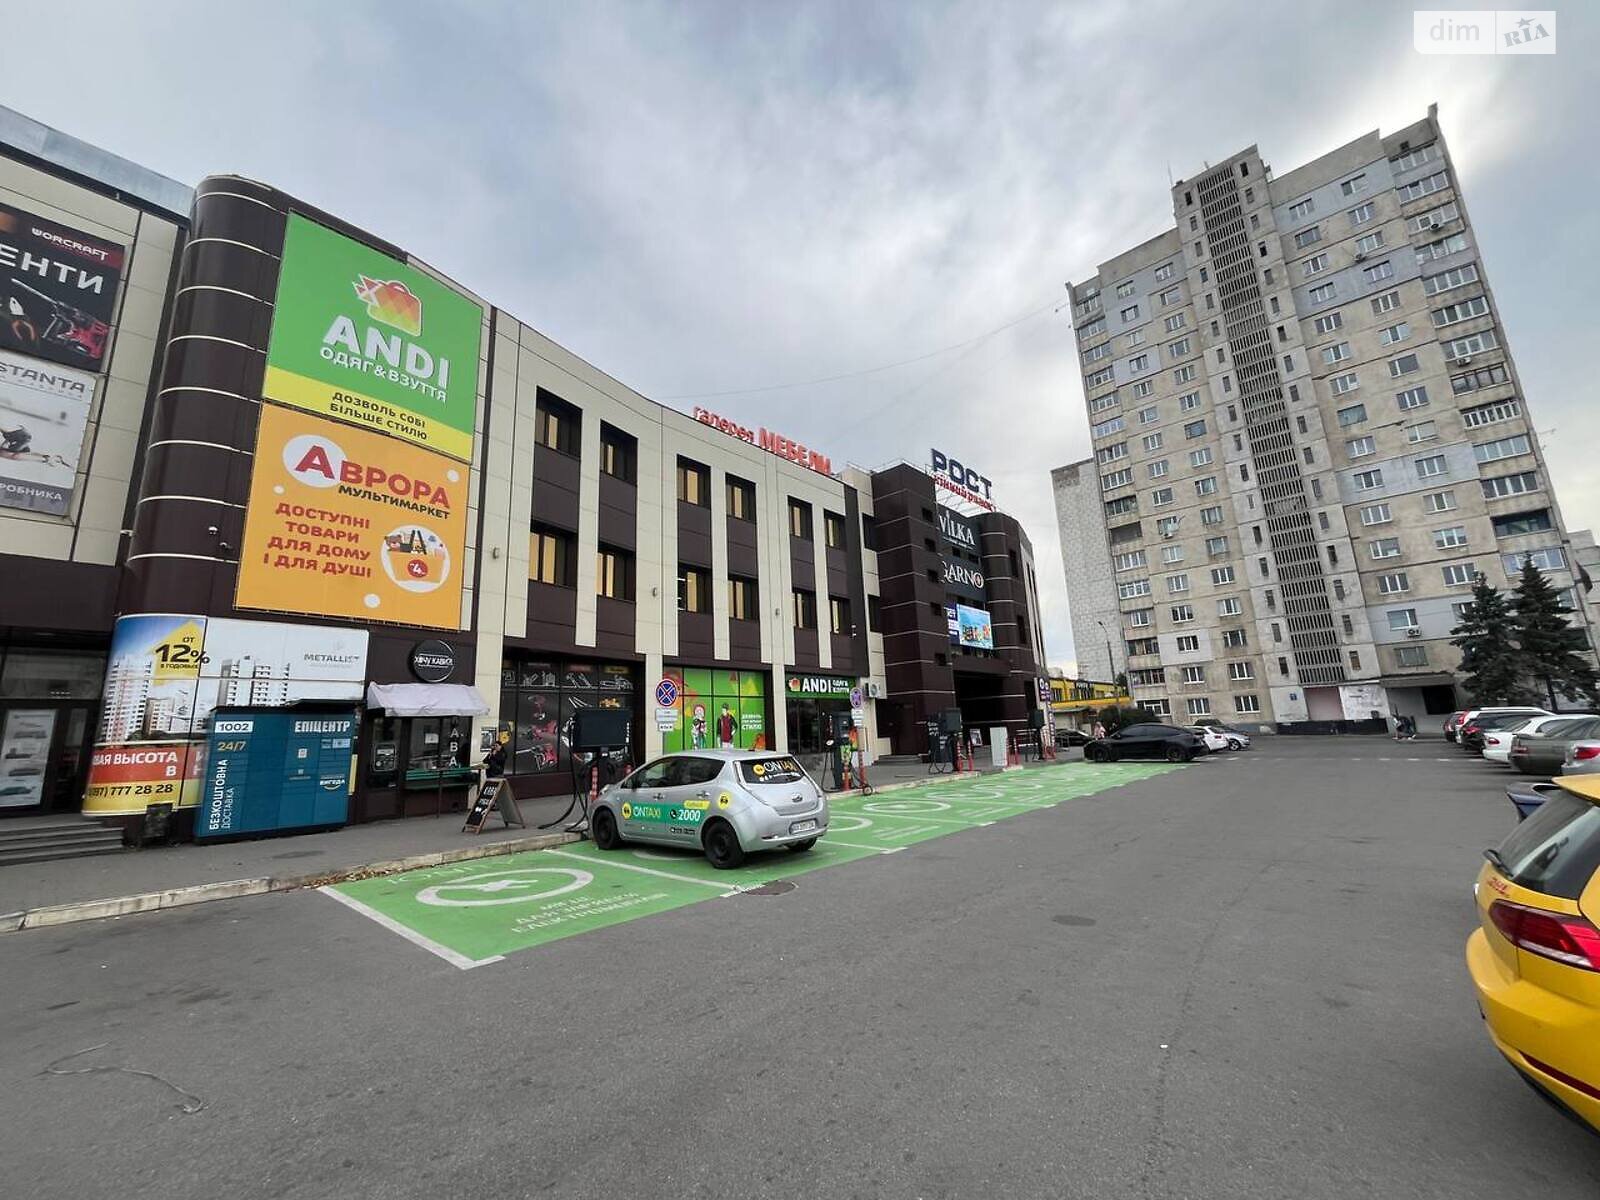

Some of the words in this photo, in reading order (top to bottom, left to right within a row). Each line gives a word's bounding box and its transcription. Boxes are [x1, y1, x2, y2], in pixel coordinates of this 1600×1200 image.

[31, 227, 109, 261] WORCRAFT
[322, 315, 451, 389] ANDI
[319, 346, 447, 402] ОДЯГ&ВЗУТТЯ
[329, 402, 383, 425] БІЛЬШЕ
[386, 418, 428, 440] СТИЛЮ
[331, 391, 396, 418] ДОЗВОЛЬ
[399, 411, 426, 428] СОБІ
[294, 445, 451, 509] АВРОРА
[931, 448, 992, 500] РОСТ
[275, 502, 371, 529] ДОСТУПНІ
[338, 485, 451, 520] МУЛЬТИМАРКЕТ
[285, 521, 360, 544] ТОВАРИ
[267, 536, 312, 553] ДЛЯ
[316, 543, 371, 562] ДОМУ
[274, 554, 318, 571] ДЛЯ
[322, 562, 372, 579] ДУШІ
[156, 643, 211, 664] 12%
[802, 678, 832, 693] ANDI
[219, 723, 250, 731] 1002
[294, 720, 351, 733] ЕПІЦЕНТР
[113, 751, 178, 765] ВЫСОТА
[217, 741, 246, 751] 24/7
[110, 785, 132, 796] 777
[134, 784, 152, 795] 28
[155, 783, 174, 794] 28
[209, 759, 229, 830] БЕЗКОШТОВНА
[221, 787, 235, 829] ДОСТАВКА
[632, 806, 661, 818] ONTAXI
[678, 809, 701, 822] 2000
